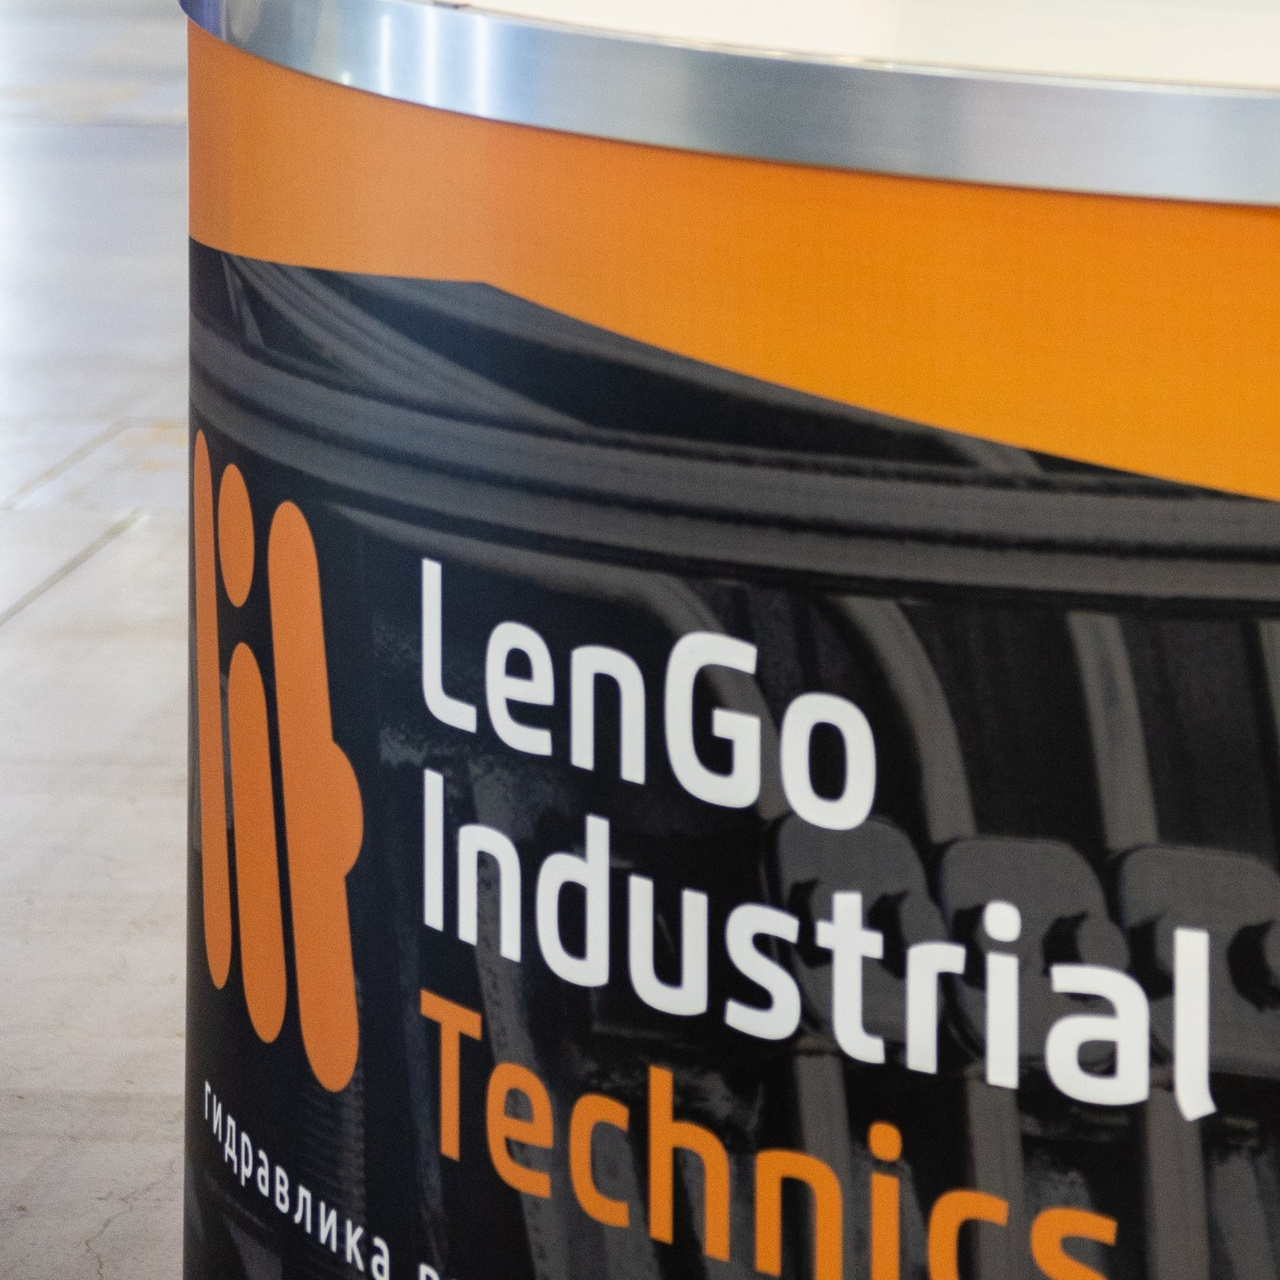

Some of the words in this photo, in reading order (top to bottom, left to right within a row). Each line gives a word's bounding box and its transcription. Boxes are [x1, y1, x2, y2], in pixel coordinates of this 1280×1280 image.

[420, 556, 878, 833] LenGo
[422, 768, 1217, 1122] Industrial
[205, 1080, 391, 1280] гидравлика
